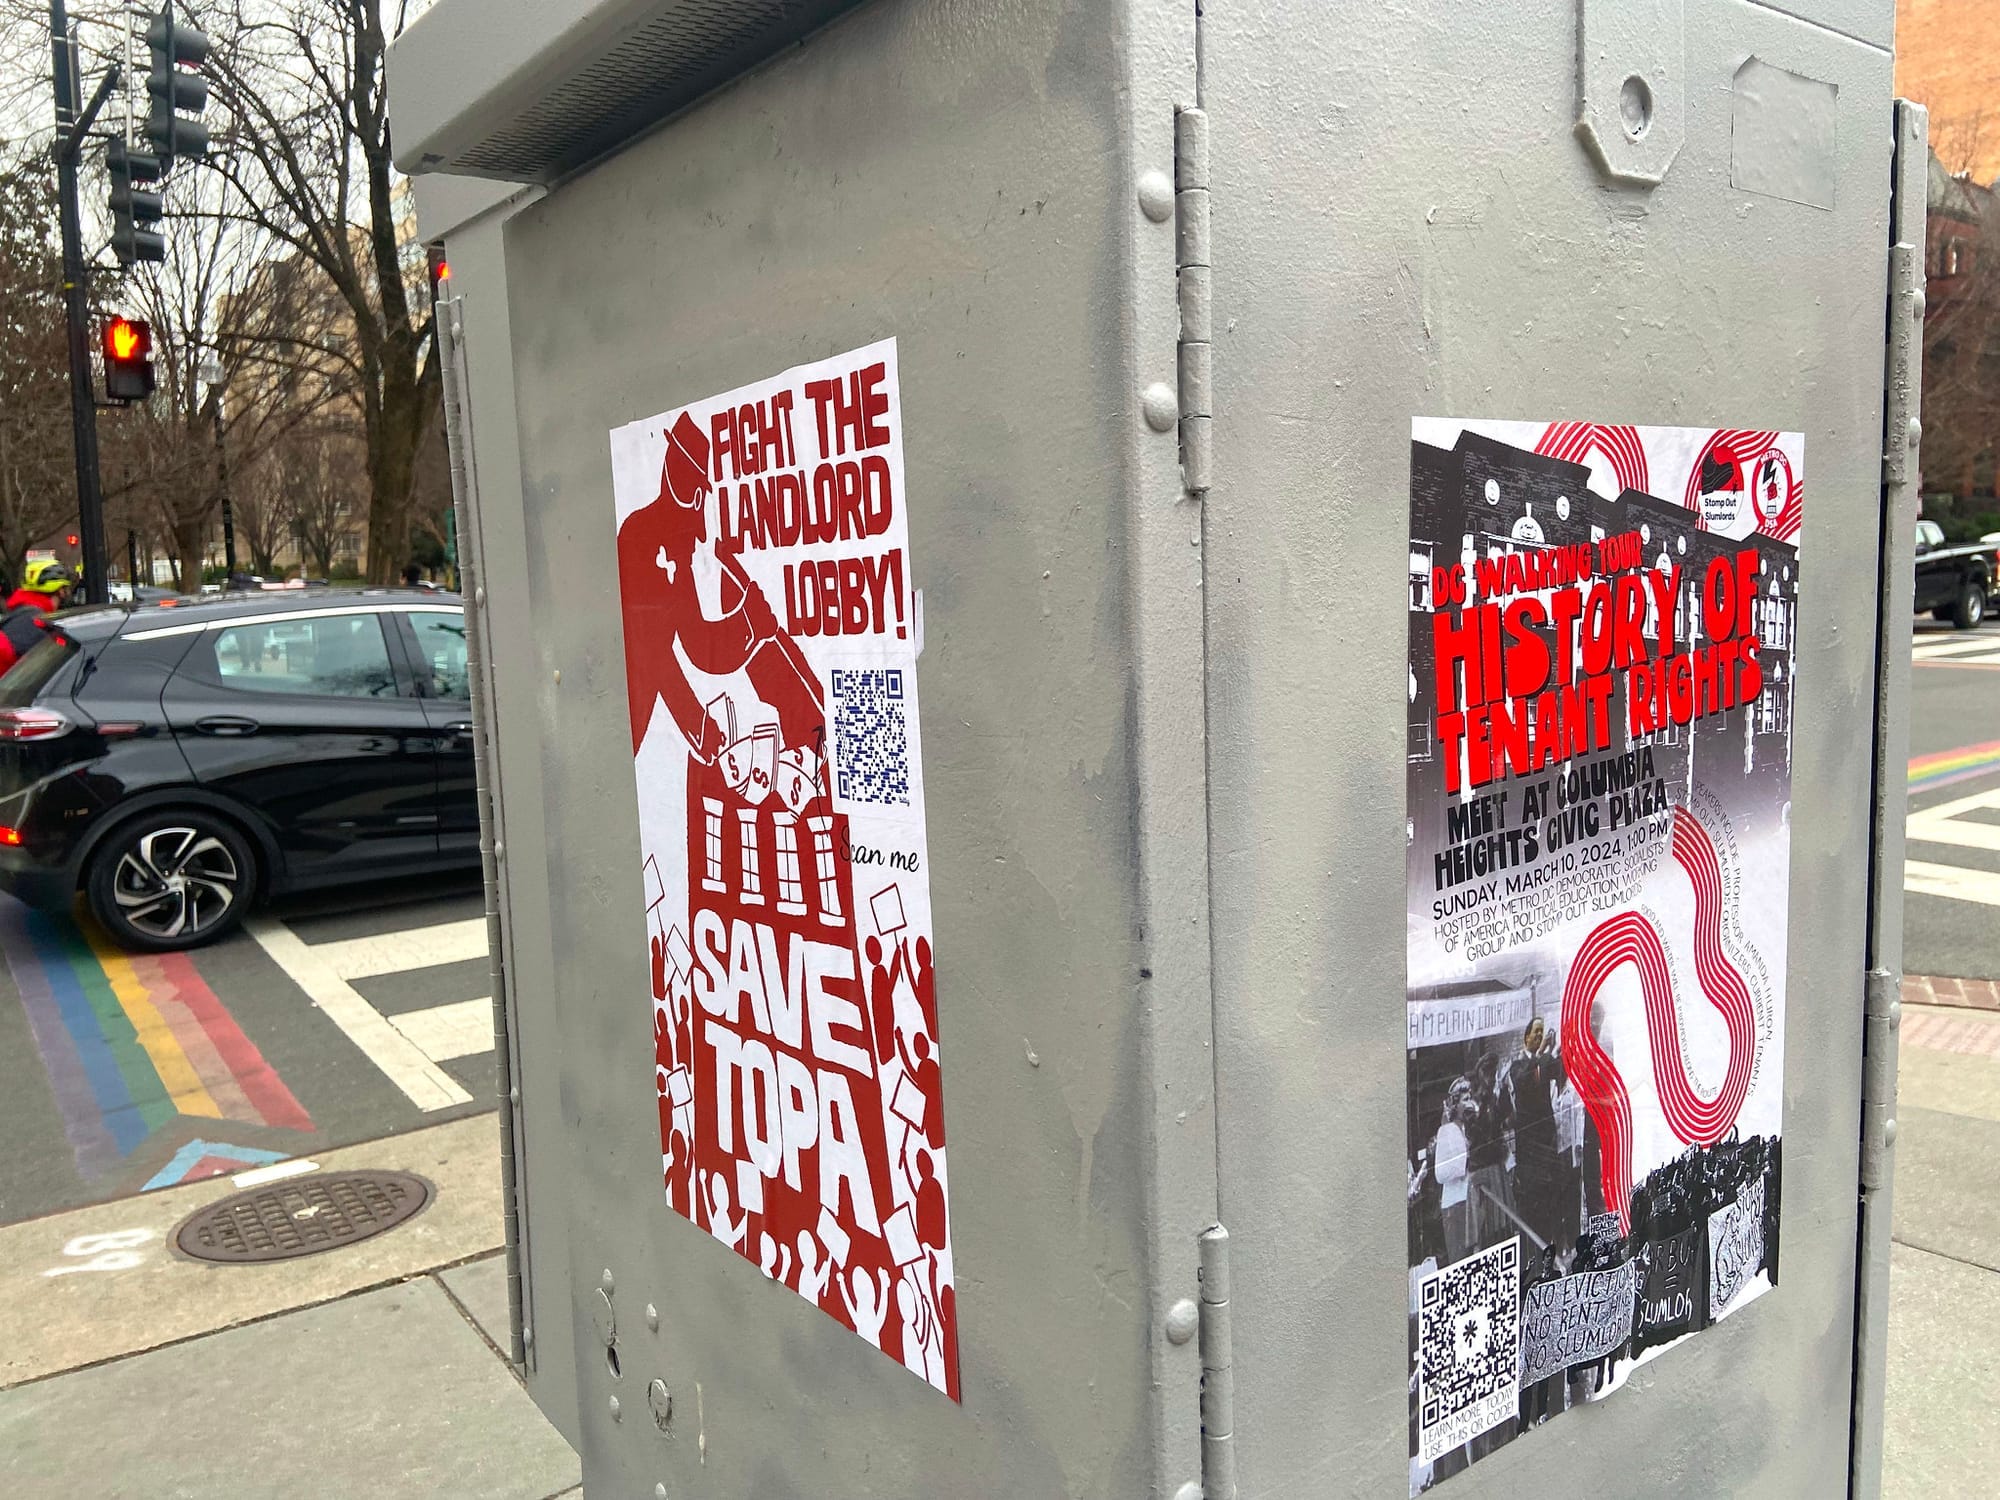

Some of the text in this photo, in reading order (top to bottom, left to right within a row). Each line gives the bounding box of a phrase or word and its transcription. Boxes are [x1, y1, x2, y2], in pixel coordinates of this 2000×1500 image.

[711, 362, 890, 482] FIGHT THE
[1761, 450, 1787, 466] METRO DC
[718, 456, 892, 553] LANDLORD
[1705, 498, 1737, 509] Stomp Out
[1705, 512, 1735, 521] Slumlords
[1764, 518, 1778, 529] DSA
[783, 548, 906, 640] LOBBY!
[1432, 531, 1643, 607] DC WALKING TOUR
[1433, 548, 1760, 716] HISTORY OF
[1437, 635, 1763, 795] TENANT RIGHTS
[1447, 745, 1655, 844] MEET AT COLUMBIA
[1700, 808, 1716, 830] OUT
[890, 850, 920, 873] me
[1433, 818, 1668, 920] SUNDAY, MARCH 10, 2024, 1:00 PM
[1434, 777, 1668, 891] HEIGHTS CIVIC PLAZA
[1434, 842, 1664, 940] HOSTED BY METRO DC DEMOCRATIC SOCIALISTS
[1445, 858, 1658, 953] OF AMERICA POLITICAL EDUCATION WORKING
[1466, 936, 1506, 962] GROUP
[1509, 927, 1533, 948] AND
[1536, 911, 1563, 937] STOMP
[1566, 901, 1588, 921] OUT
[693, 909, 873, 1080] SAVE
[704, 1019, 882, 1239] TOPA
[1525, 1314, 1551, 1342] NO
[1559, 1299, 1607, 1334] RENT
[1527, 1283, 1555, 1316] NO
[1525, 1345, 1547, 1372] NO
[1423, 1385, 1514, 1446] LEARN MORE TODAY
[1424, 1439, 1443, 1460] USE
[1447, 1426, 1467, 1447] THIS
[1470, 1417, 1483, 1434] QR
